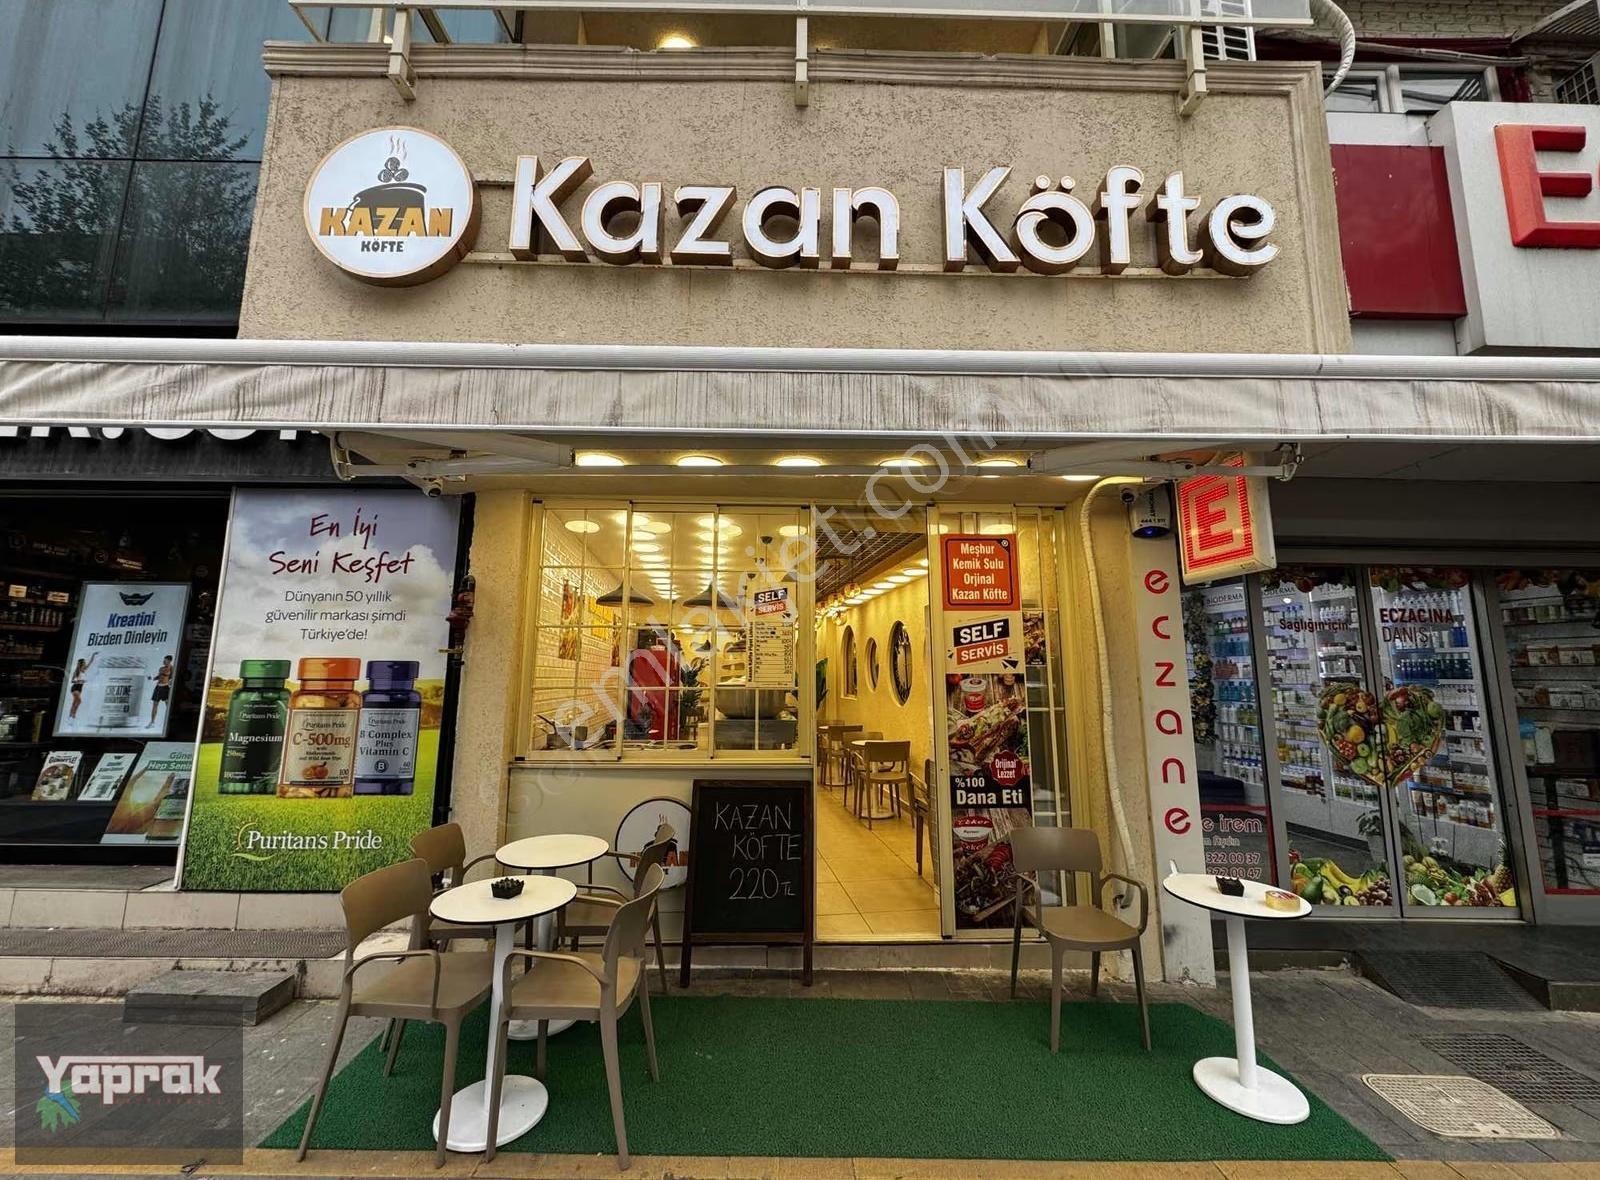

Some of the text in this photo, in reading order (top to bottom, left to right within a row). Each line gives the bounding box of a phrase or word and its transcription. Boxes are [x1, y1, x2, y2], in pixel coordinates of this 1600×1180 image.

[1493, 123, 1600, 248] E
[510, 155, 1280, 268] Kazan Köfte
[318, 207, 454, 237] KAZAN
[361, 239, 405, 253] KÖFTE
[1194, 482, 1234, 551] E
[309, 507, 378, 549] En İyi
[960, 542, 995, 557] Meşhur
[269, 550, 415, 583] Seni Keşfet
[952, 557, 1004, 569] Kemik Sulu
[963, 573, 995, 586] Orjinal
[284, 590, 392, 605] Dünyanın 50 yıllık
[757, 589, 785, 603] SELF
[952, 588, 1008, 600] Kazan Köfte
[107, 611, 156, 628] Kreatini
[265, 609, 406, 624] güvenilir markası şimdi
[1380, 608, 1455, 624] ECZACINA
[87, 629, 168, 646] Bizden Dinleyin
[300, 628, 368, 642] Türkiye'de!
[959, 621, 1005, 644] SELF
[960, 643, 1005, 661] SERVİS
[1144, 570, 1191, 835] eczane
[228, 732, 283, 745] Magnesium
[368, 730, 412, 740] Complex
[360, 746, 399, 756] Vitamin
[954, 777, 985, 788] %100
[956, 789, 1023, 805] Dana Eti
[714, 802, 792, 831] KAZAN
[246, 829, 383, 850] Puritan's Pride
[732, 832, 801, 861] KÖFTE
